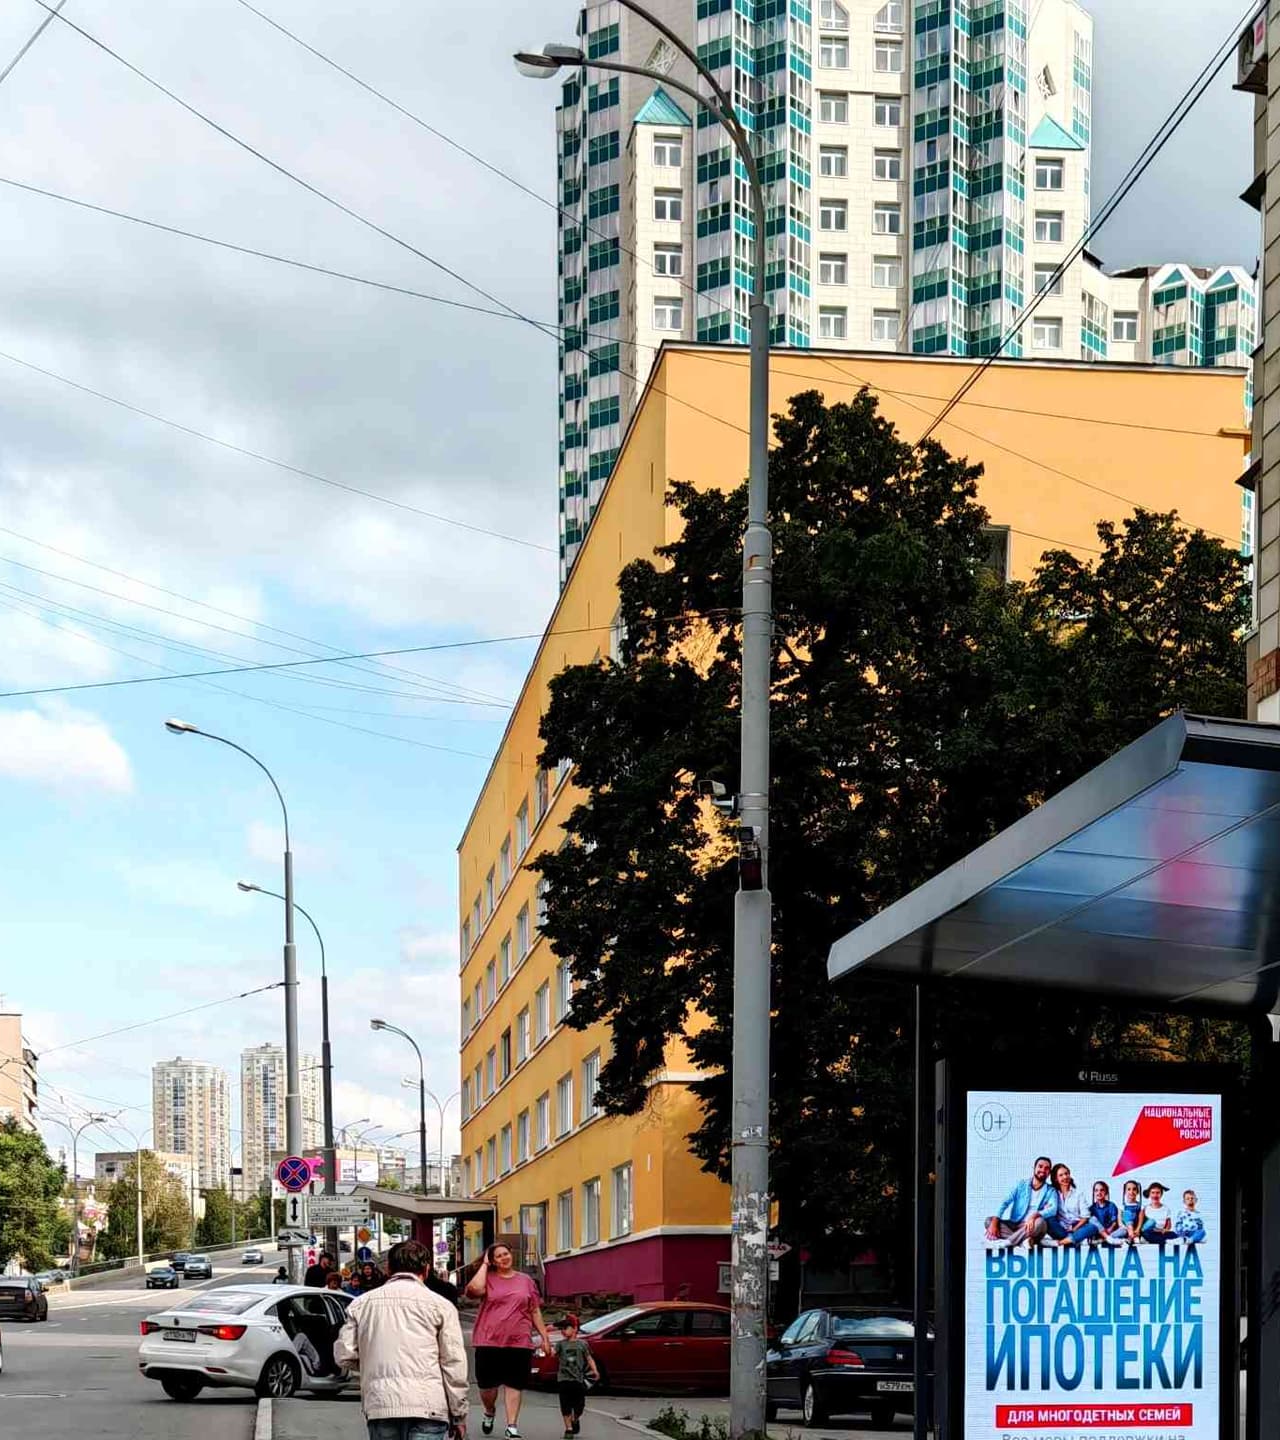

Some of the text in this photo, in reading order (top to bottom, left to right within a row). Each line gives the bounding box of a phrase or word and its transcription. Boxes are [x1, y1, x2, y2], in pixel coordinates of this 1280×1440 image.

[981, 1110, 1006, 1132] 0+
[1144, 1107, 1211, 1119] НАЦИОНАЛЬНЫЕ
[1173, 1118, 1211, 1129] ПРОЕКТЫ
[1180, 1129, 1211, 1140] РОССИИ
[985, 1244, 1203, 1278] ВЫПЛАТА НА
[985, 1279, 1203, 1324] ПОГАШЕНИЕ
[985, 1323, 1203, 1391] ИПОТЕКИ
[1007, 1405, 1181, 1424] ДЛЯ МНОГОДЕТНЫХ СЕМЕЙ
